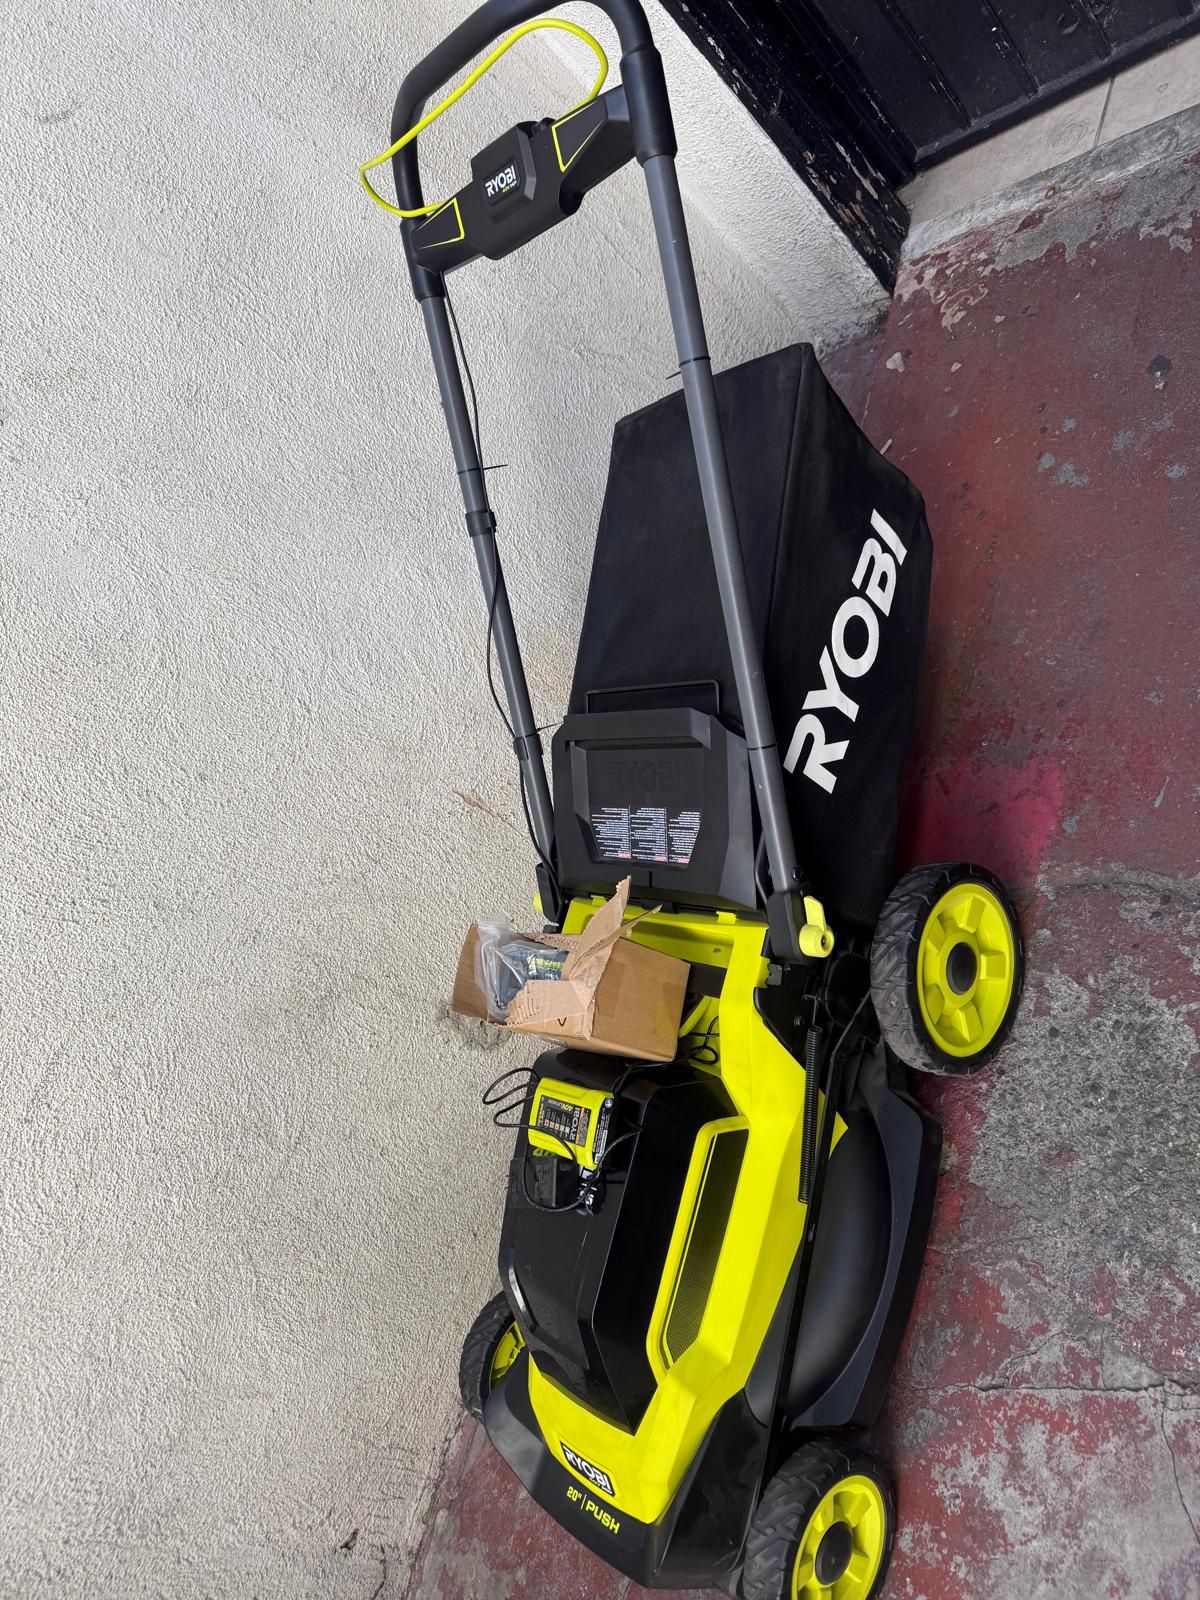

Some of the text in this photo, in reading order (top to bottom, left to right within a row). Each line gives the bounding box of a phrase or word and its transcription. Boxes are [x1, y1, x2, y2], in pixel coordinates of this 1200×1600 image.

[485, 165, 517, 197] RYOBI
[783, 508, 908, 794] RYOBI
[569, 1107, 581, 1140] RYOBI
[562, 1445, 611, 1491] RYOBI
[566, 1486, 621, 1534] 20" PUSH
